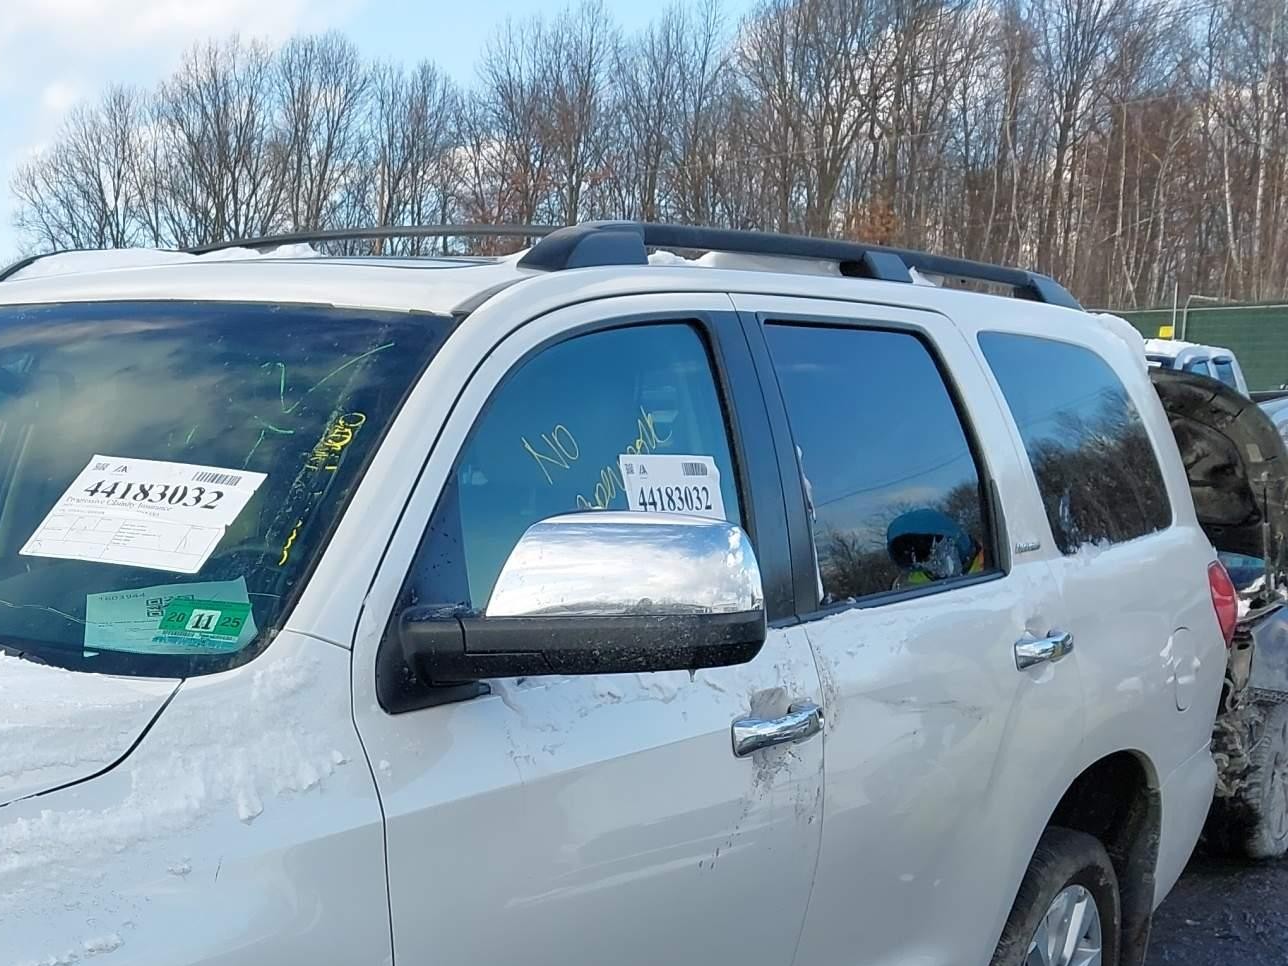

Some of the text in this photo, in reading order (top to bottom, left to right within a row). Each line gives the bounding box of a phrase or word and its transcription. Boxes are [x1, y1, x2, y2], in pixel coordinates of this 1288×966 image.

[83, 479, 225, 510] 44183032
[638, 485, 713, 511] 44183032
[167, 611, 241, 630] 20 11 25
